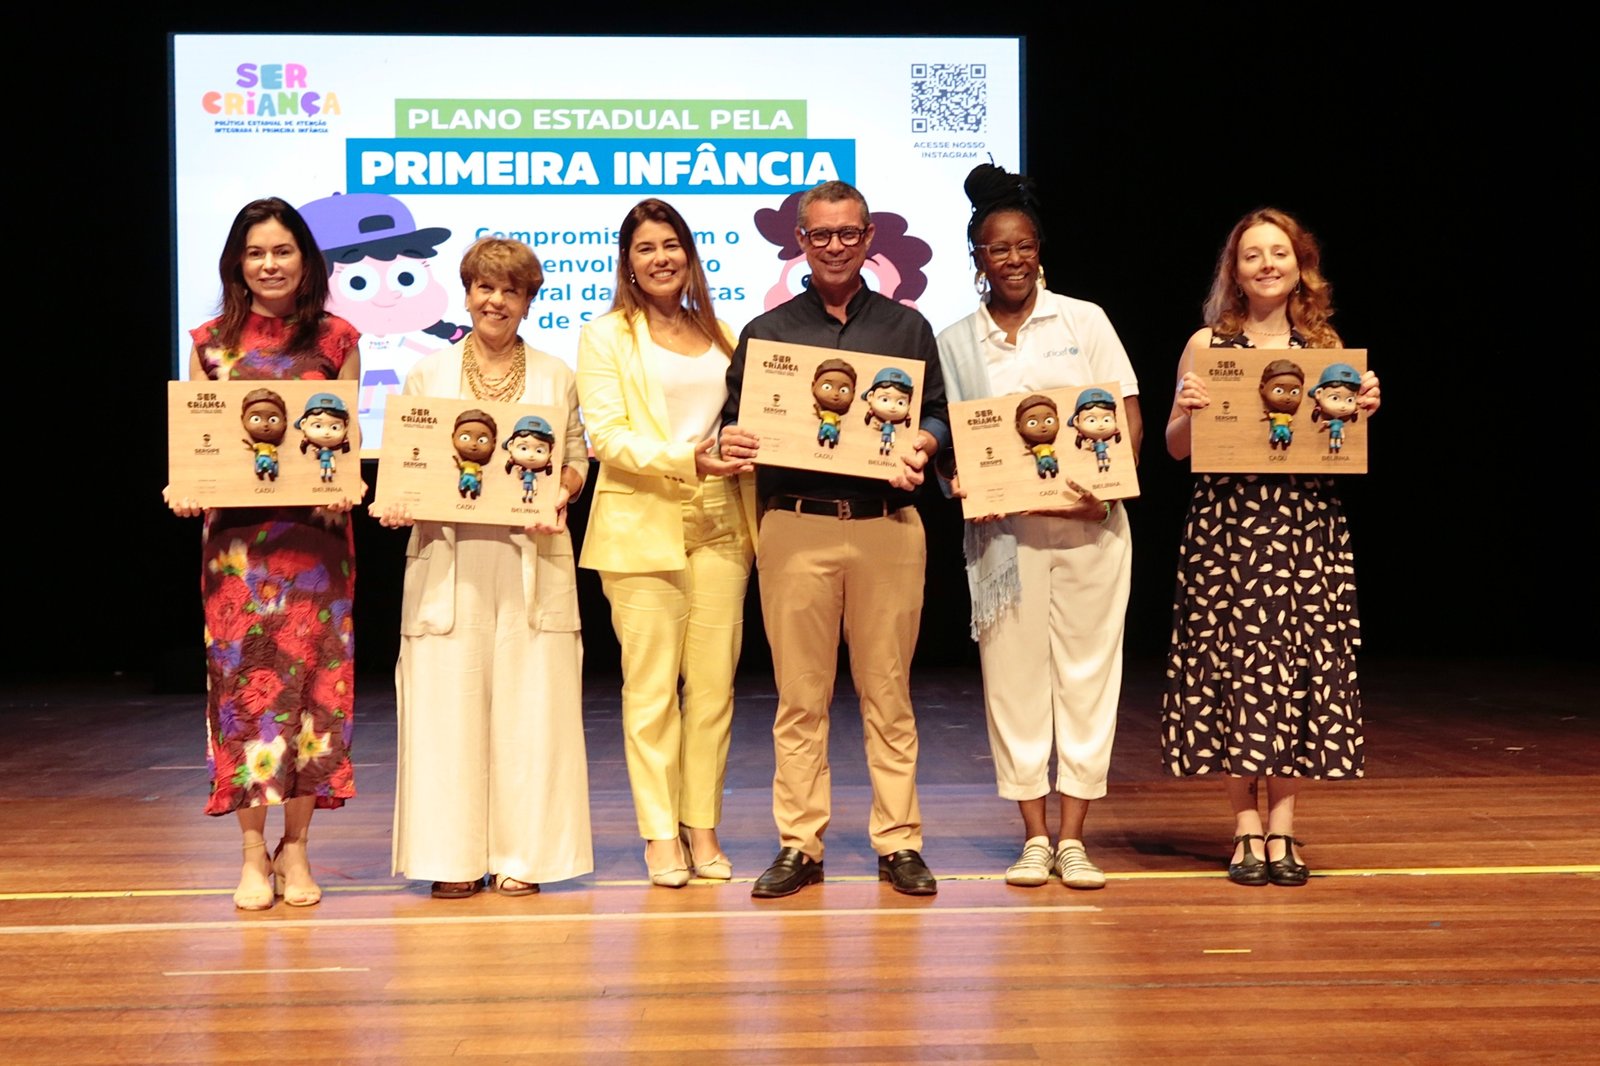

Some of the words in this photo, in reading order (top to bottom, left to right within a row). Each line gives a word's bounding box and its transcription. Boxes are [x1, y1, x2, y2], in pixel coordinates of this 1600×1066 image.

[236, 63, 307, 89] SER
[408, 108, 522, 130] PLANO
[533, 108, 699, 130] ESTADUAL
[710, 109, 794, 130] PELA
[361, 151, 600, 186] PRIMEIRA
[613, 142, 840, 186] INFÂNCIA
[725, 231, 740, 245] o
[538, 312, 570, 328] de
[773, 354, 791, 363] SER
[1217, 360, 1236, 368] SER
[197, 392, 217, 401] SER
[411, 408, 430, 416] SER
[975, 409, 993, 417] SER
[814, 452, 834, 460] CADU
[1039, 489, 1058, 497] CADU
